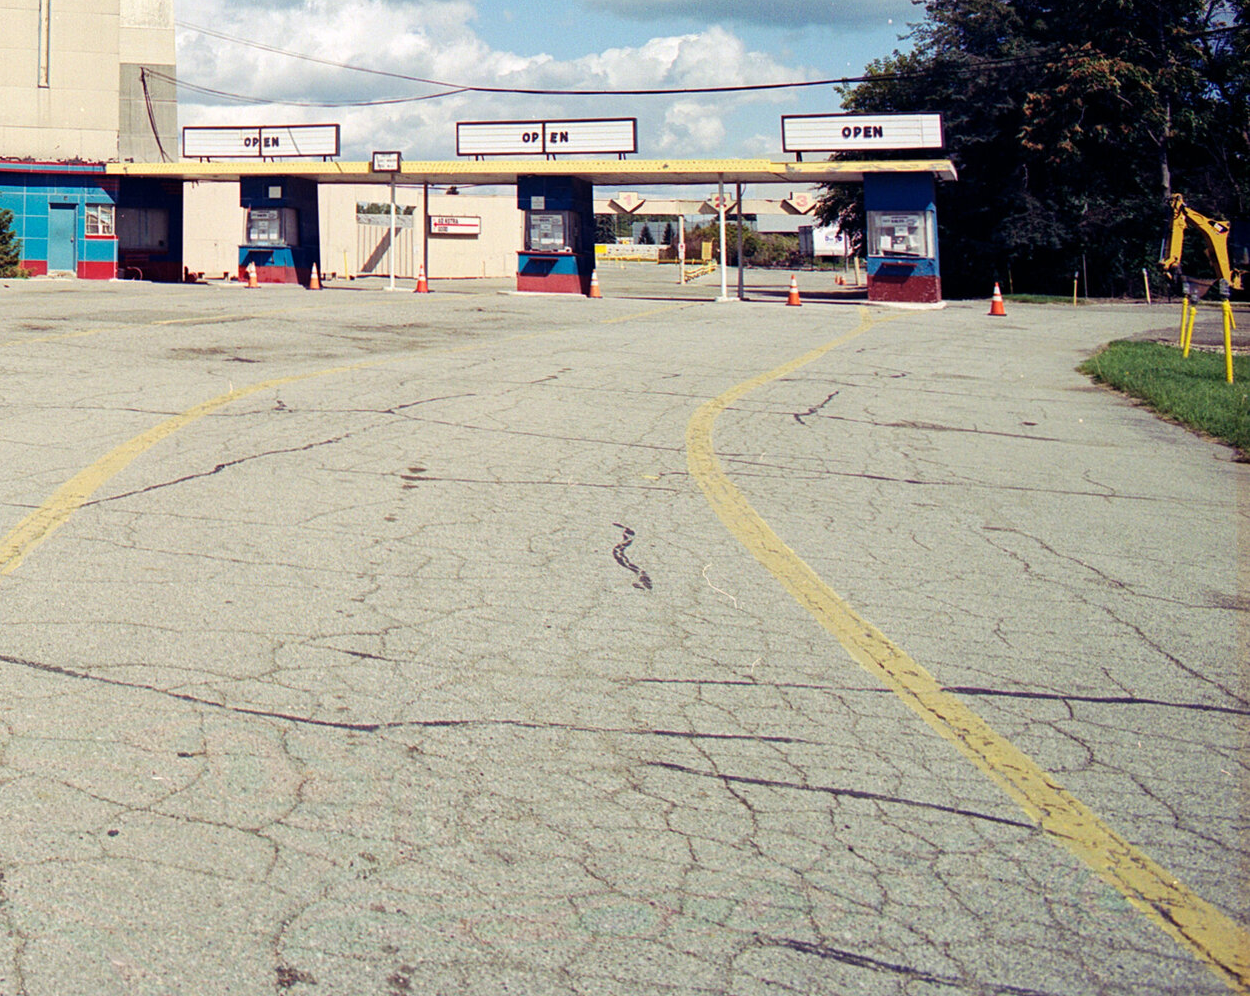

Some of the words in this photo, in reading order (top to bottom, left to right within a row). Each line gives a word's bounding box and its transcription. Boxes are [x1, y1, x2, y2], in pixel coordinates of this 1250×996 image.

[522, 131, 569, 143] OPEN
[841, 126, 883, 139] OPEN
[244, 136, 279, 147] OPEN
[795, 195, 808, 207] 3
